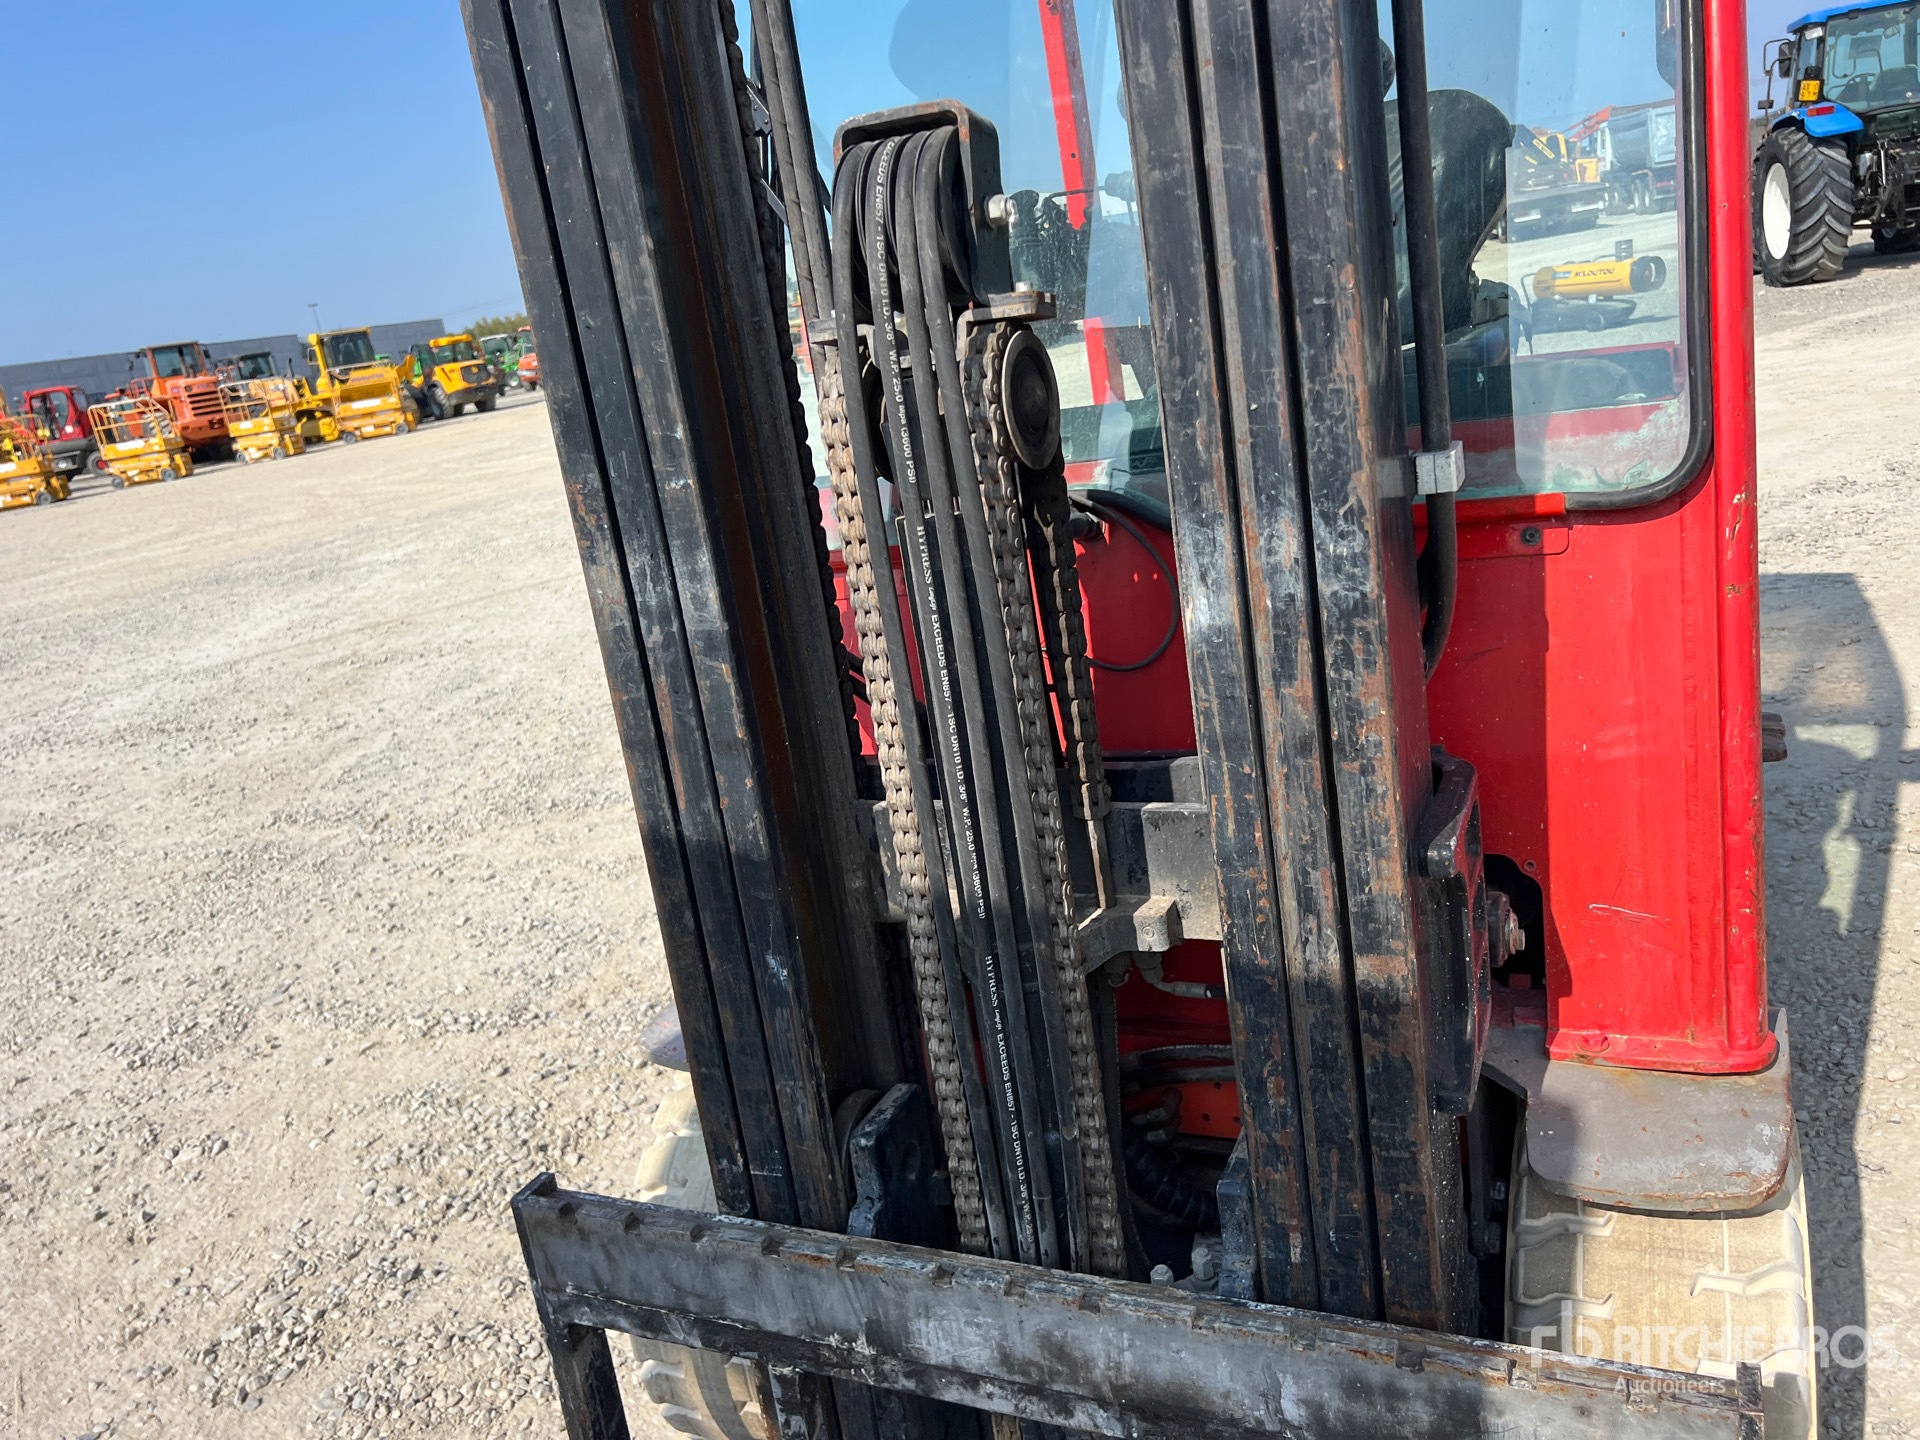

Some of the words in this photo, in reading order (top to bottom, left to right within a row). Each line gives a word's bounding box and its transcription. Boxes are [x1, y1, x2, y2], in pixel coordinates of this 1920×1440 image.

[877, 235, 885, 260] 1SC
[879, 263, 888, 296] DN10
[906, 459, 917, 484] PSI)
[917, 525, 933, 584] HYPRESS
[931, 613, 946, 668] EXCEEDS
[940, 669, 952, 703] EN857
[947, 711, 956, 733] 1SC
[951, 735, 962, 764] DN10
[976, 899, 986, 920] PSI)
[985, 955, 999, 1007] HYPRESS
[997, 1033, 1010, 1081] EXCEEDS
[1005, 1082, 1014, 1112] EN857
[1010, 1120, 1019, 1140] 1SC
[1013, 1140, 1023, 1166] DN10
